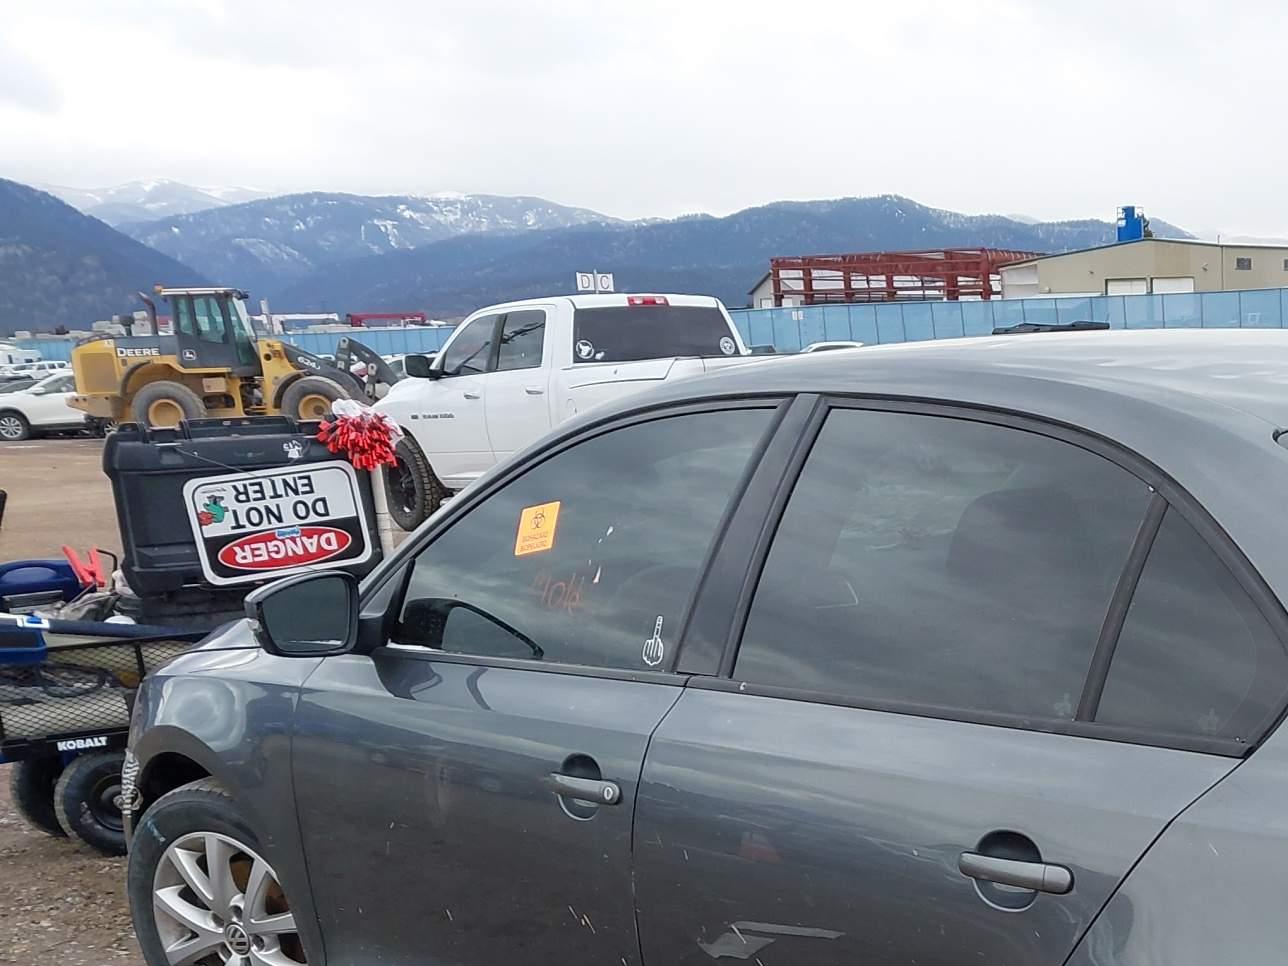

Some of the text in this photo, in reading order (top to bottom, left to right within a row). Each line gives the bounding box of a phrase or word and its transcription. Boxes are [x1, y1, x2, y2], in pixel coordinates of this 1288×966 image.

[580, 274, 592, 290] D
[599, 274, 610, 290] C
[116, 347, 161, 358] DEERE
[231, 474, 315, 503] ENTER
[230, 496, 330, 530] DO NOT
[233, 532, 339, 564] DANGER
[57, 736, 108, 751] KOBALT
